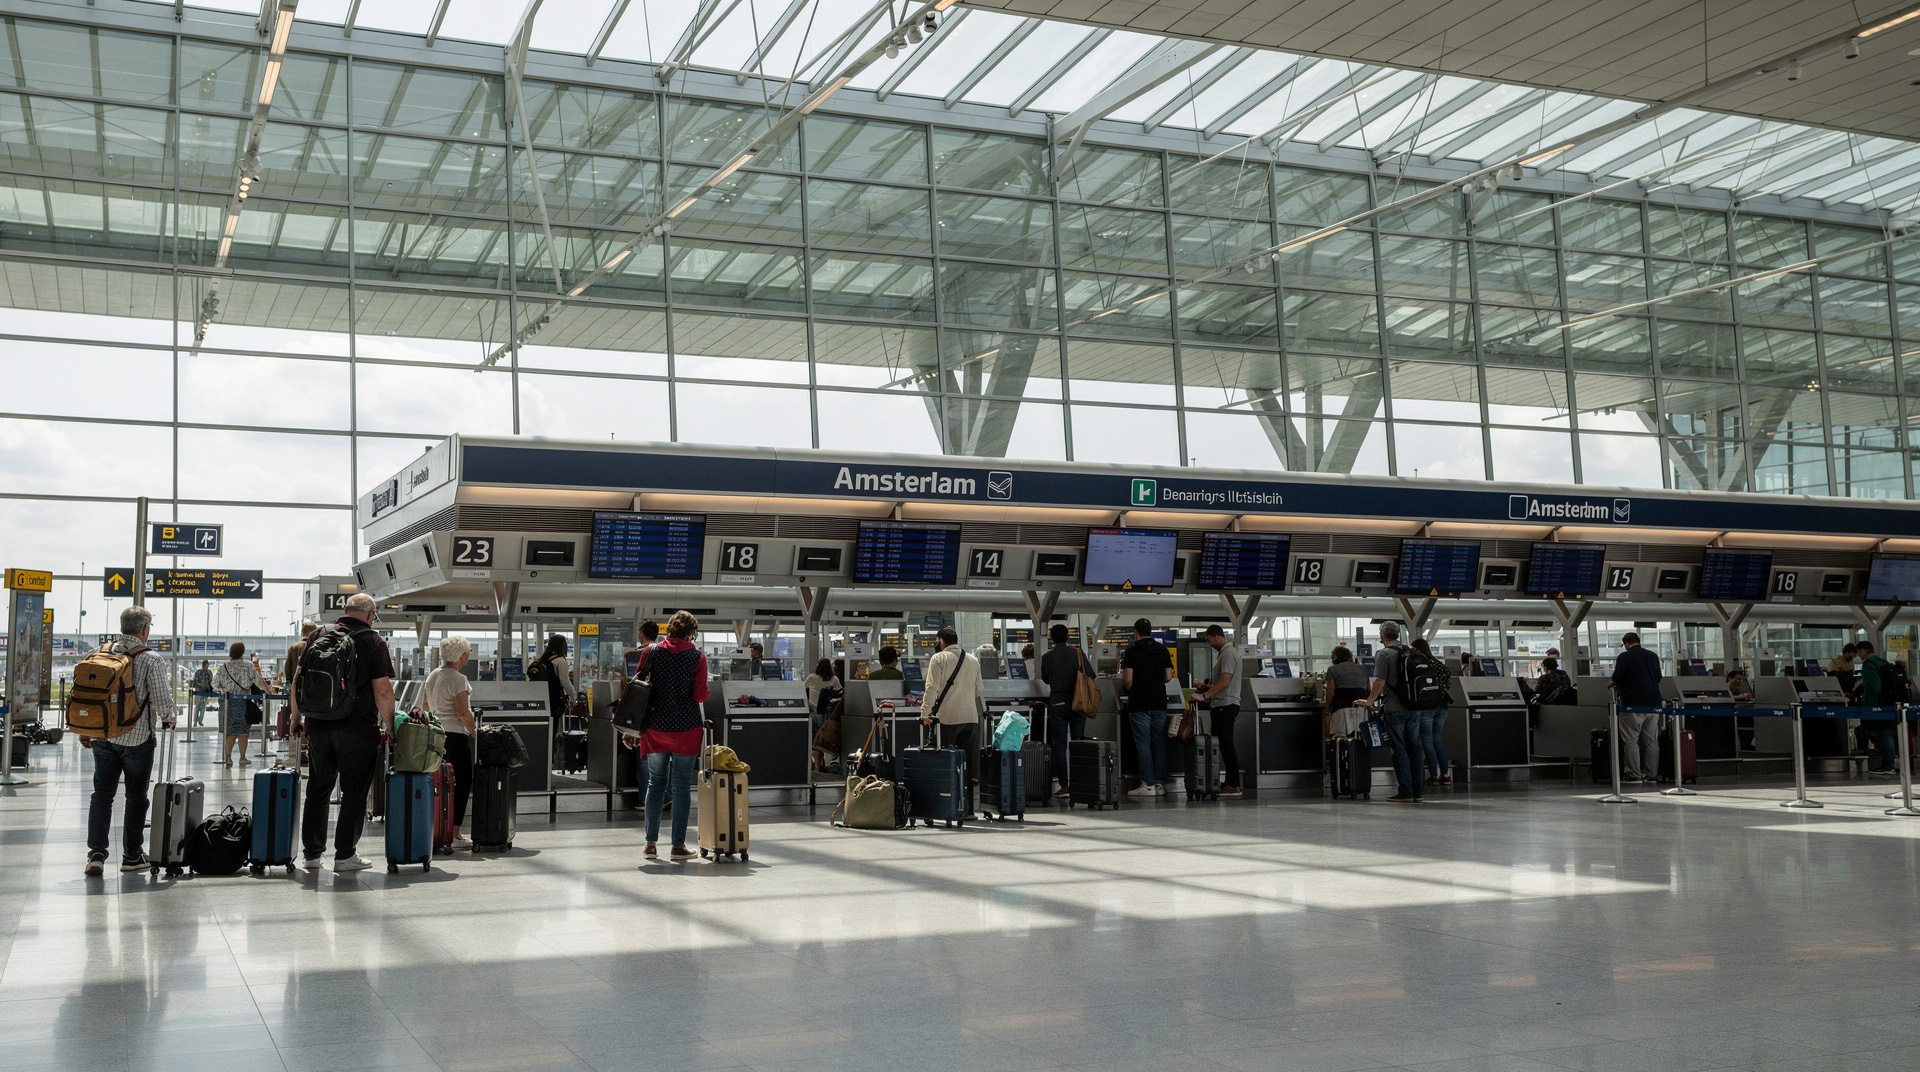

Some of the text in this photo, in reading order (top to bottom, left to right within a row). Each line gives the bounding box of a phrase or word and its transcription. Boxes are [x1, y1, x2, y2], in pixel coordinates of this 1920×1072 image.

[456, 540, 490, 563] 23
[727, 546, 754, 568] 18
[975, 551, 999, 573] 14
[1299, 561, 1321, 581] 18
[1612, 569, 1631, 588] 15
[1777, 573, 1796, 591] 18
[328, 595, 346, 609] 14
